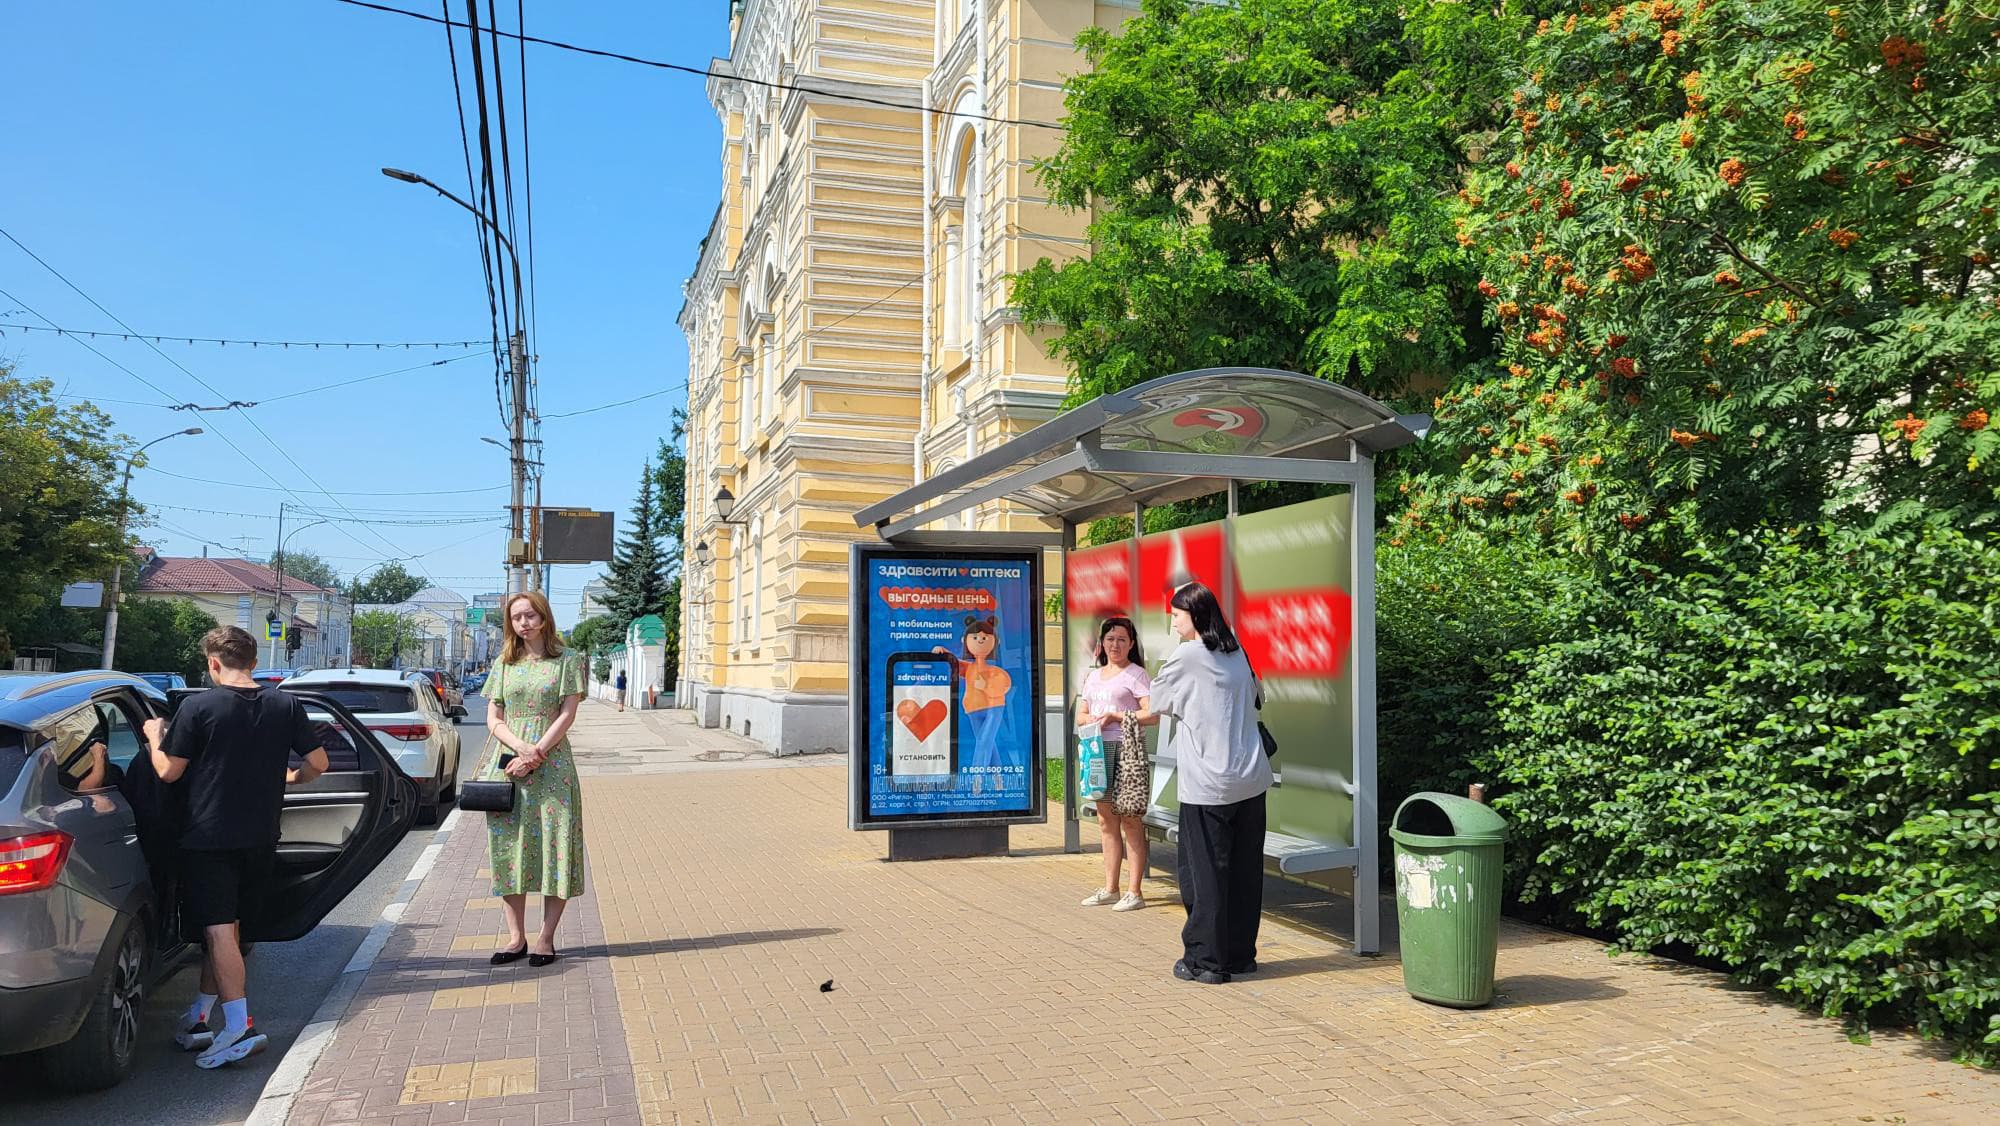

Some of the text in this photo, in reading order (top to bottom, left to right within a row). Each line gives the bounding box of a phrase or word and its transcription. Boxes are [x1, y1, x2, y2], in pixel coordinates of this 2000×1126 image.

[879, 565, 1020, 579] здравсити аптека
[888, 593, 989, 605] ВЫГОДНЫЕ ЦЕНЫ
[898, 619, 953, 628] мобильном
[890, 632, 953, 641] приложении
[897, 672, 947, 683] zdravcity.ru
[899, 754, 946, 762] УСТАНОВИТЬ
[873, 764, 888, 775] 18+
